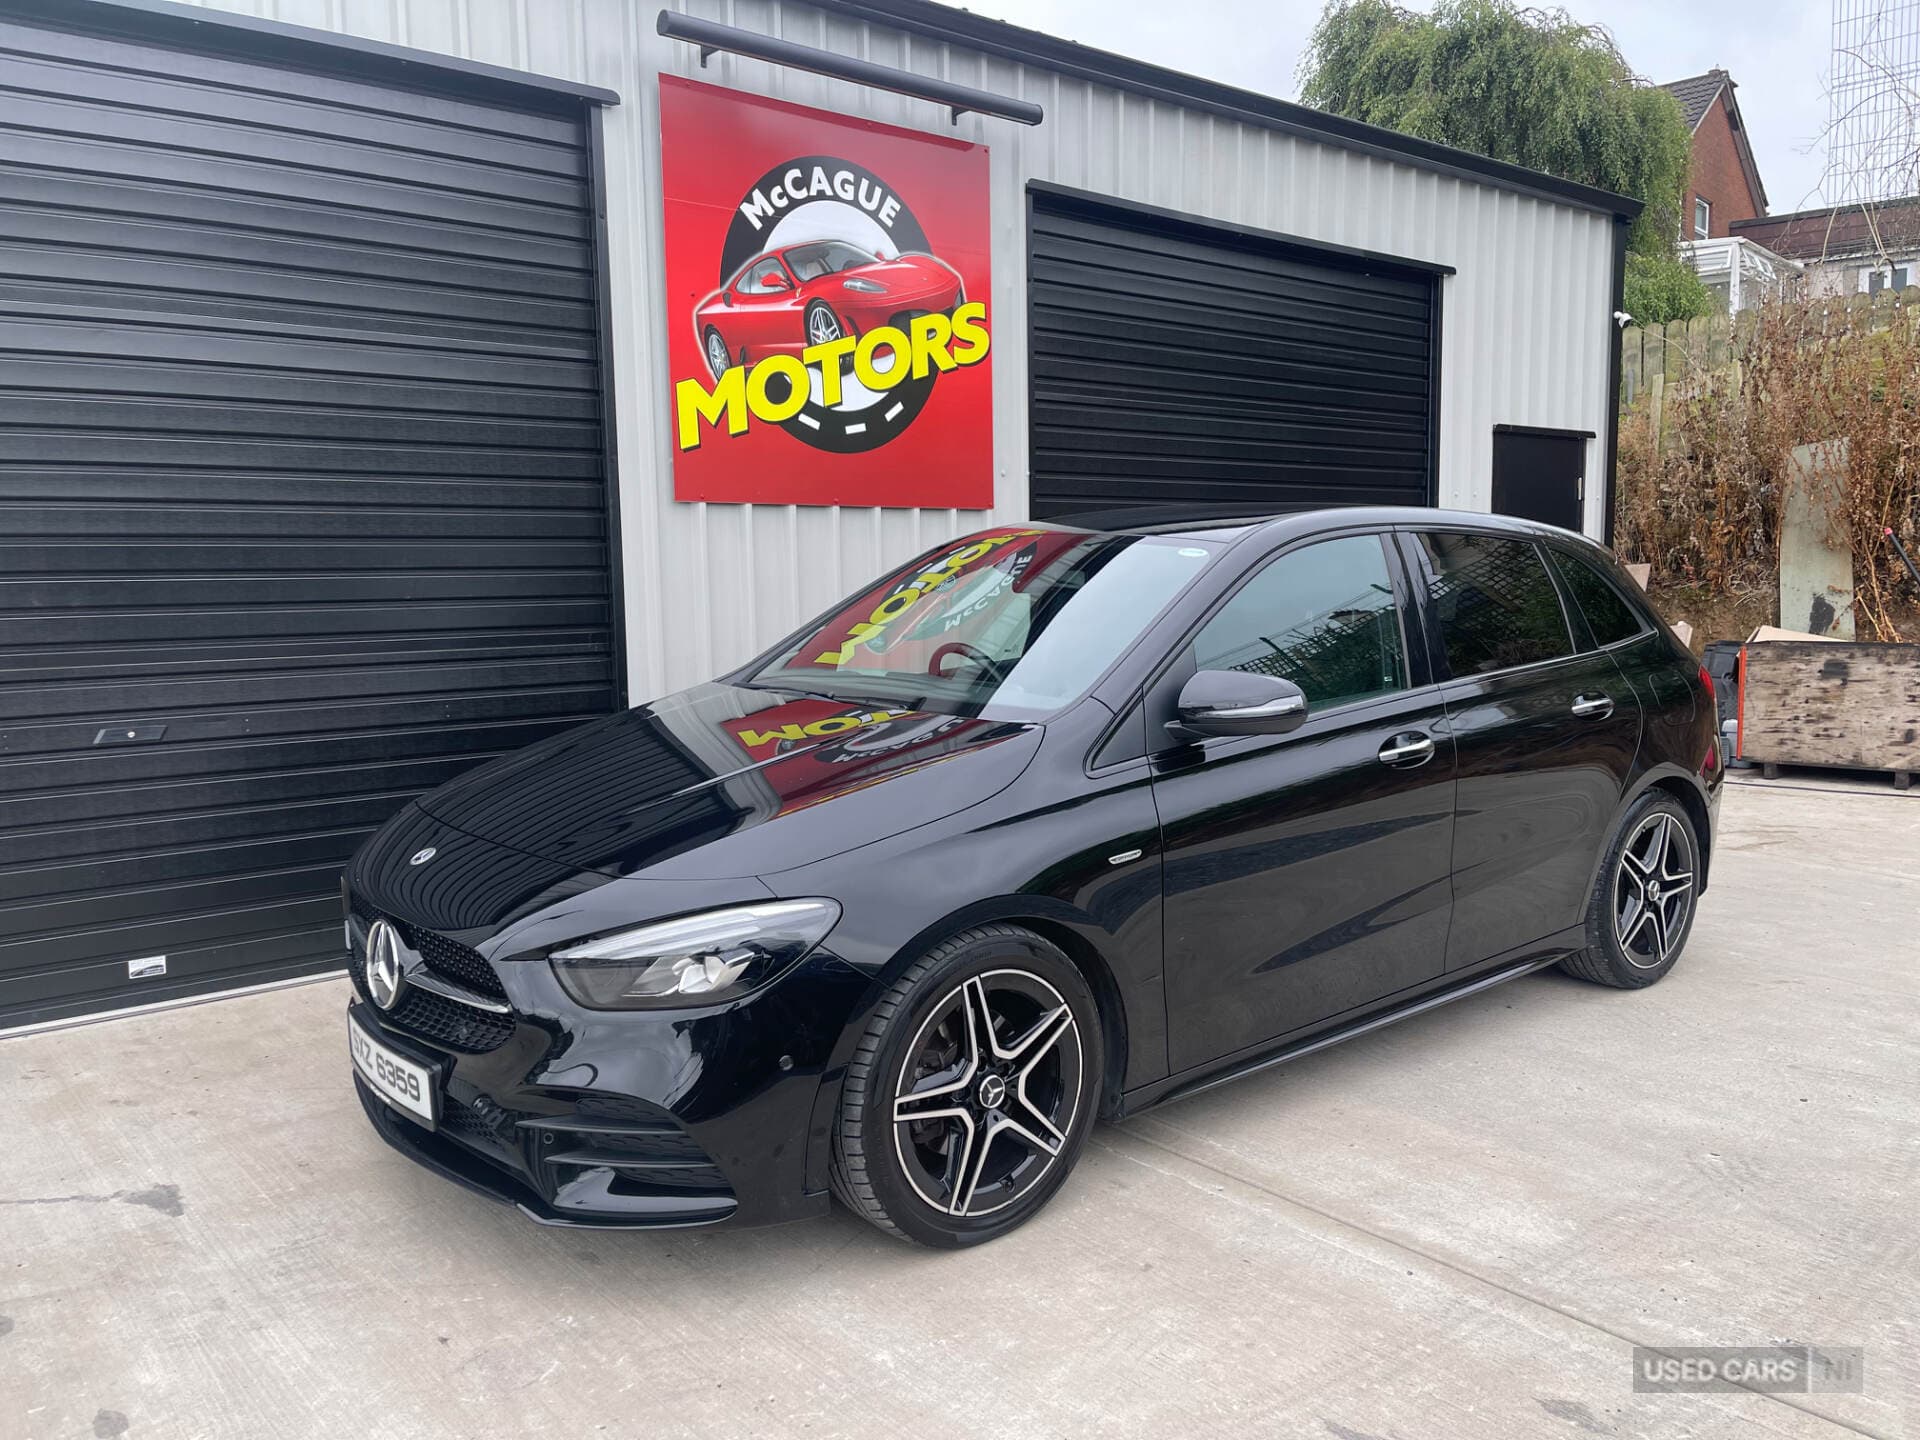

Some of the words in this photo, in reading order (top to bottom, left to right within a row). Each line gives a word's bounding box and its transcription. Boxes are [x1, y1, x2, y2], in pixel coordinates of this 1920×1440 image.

[740, 166, 901, 231] McCAGUE
[676, 302, 991, 452] MOTORS
[376, 1052, 420, 1102] 6359
